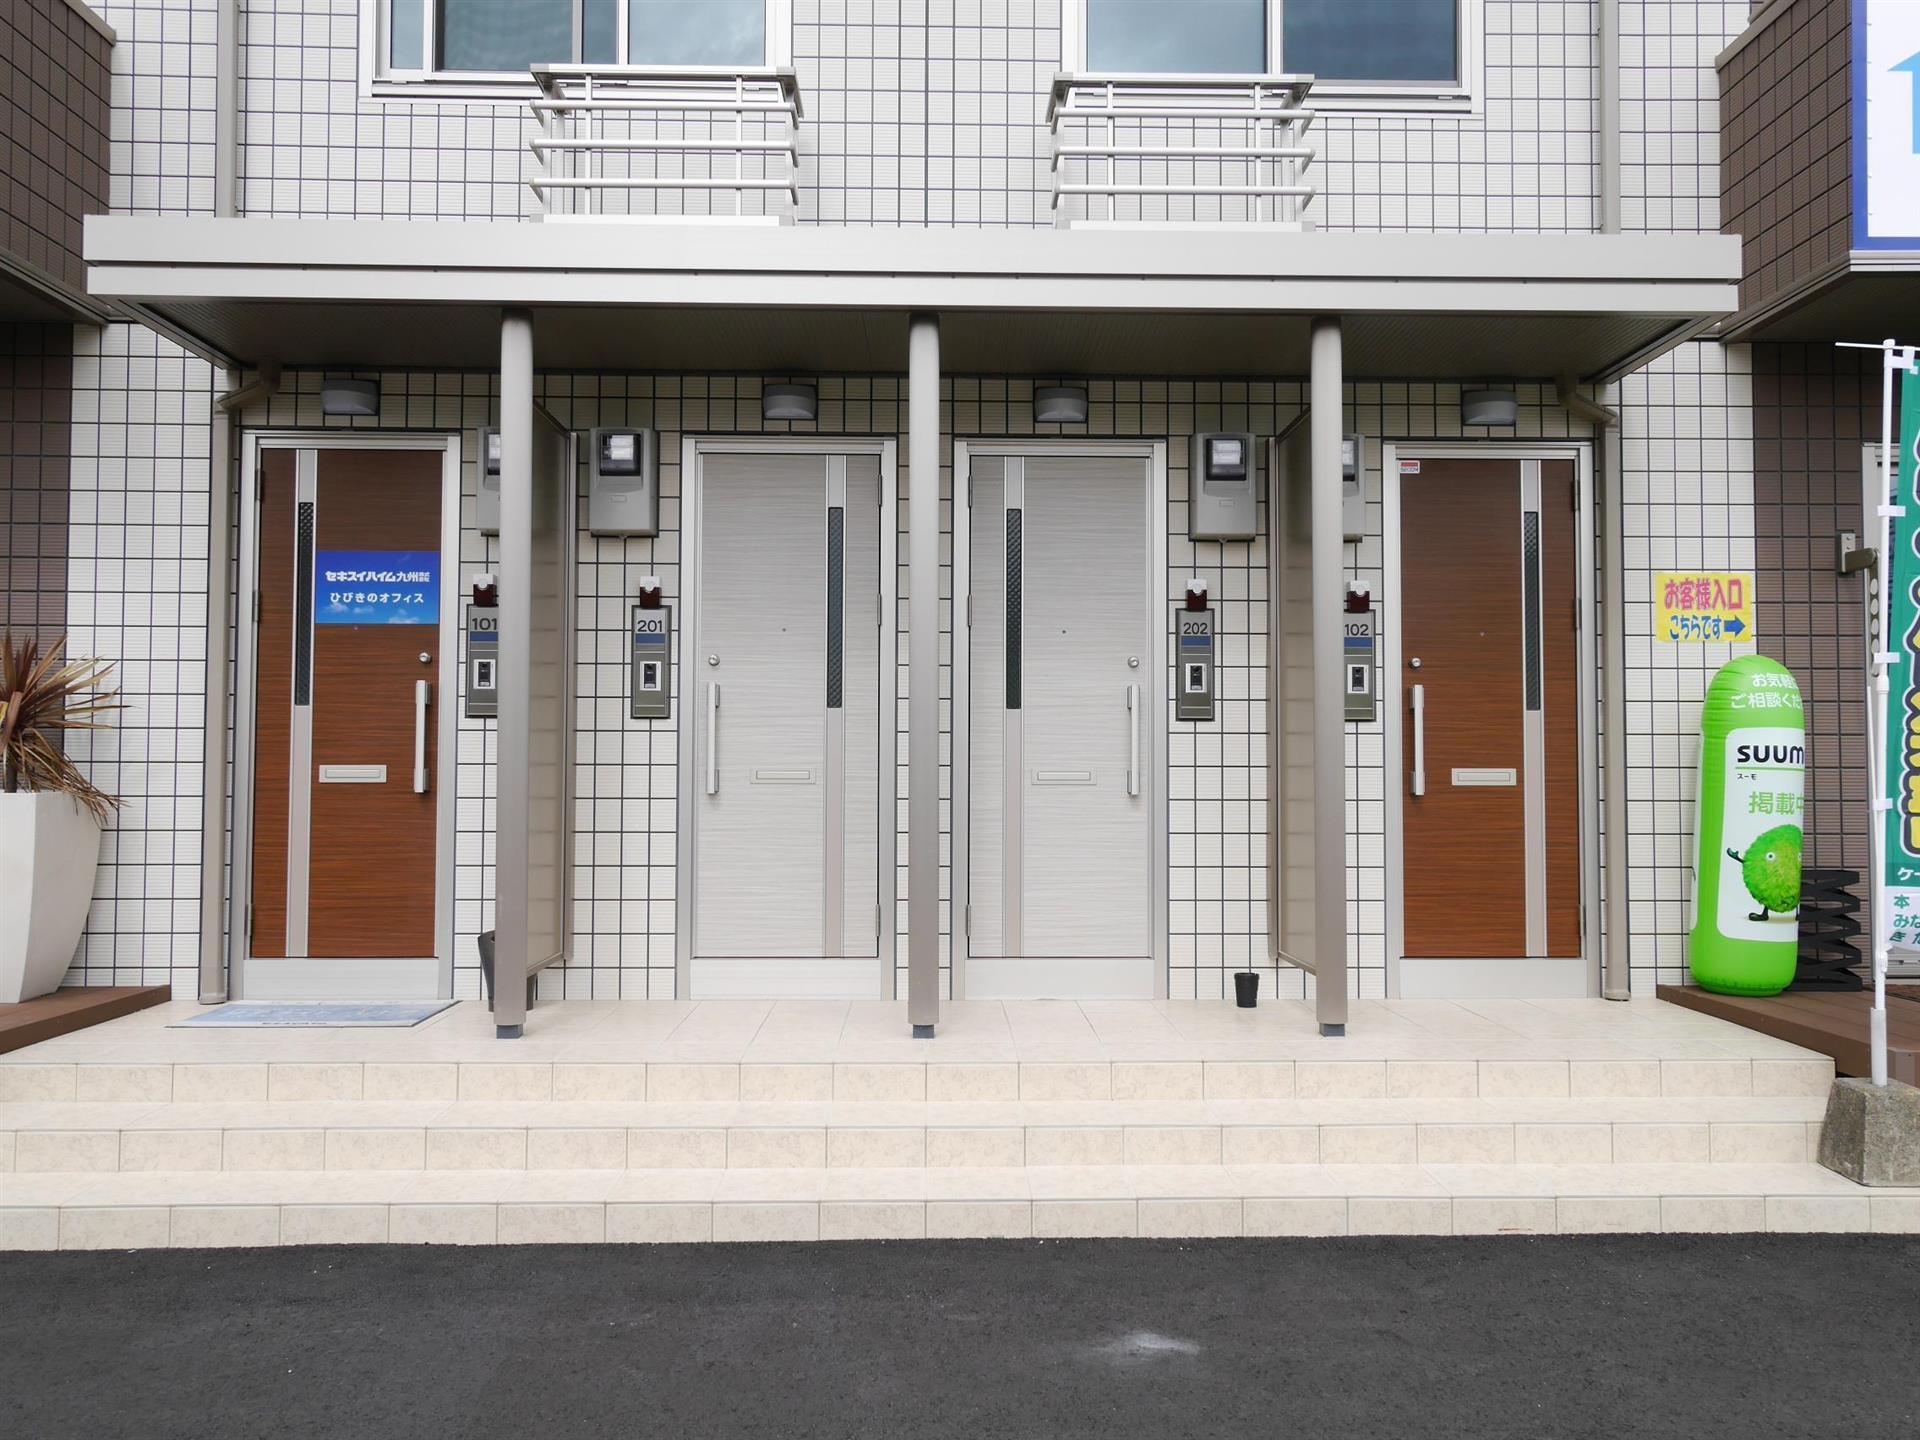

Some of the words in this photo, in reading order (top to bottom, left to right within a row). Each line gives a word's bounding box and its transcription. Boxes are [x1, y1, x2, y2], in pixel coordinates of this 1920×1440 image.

[330, 592, 424, 603] ひびきのオフィス
[1664, 577, 1743, 610] お客様入口
[472, 617, 497, 631] 101
[637, 620, 663, 633] 201
[1183, 622, 1208, 635] 202
[1344, 623, 1369, 636] 102
[1669, 614, 1722, 640] こちらです
[1737, 773, 1757, 781] スーモ
[1893, 894, 1910, 909] 本
